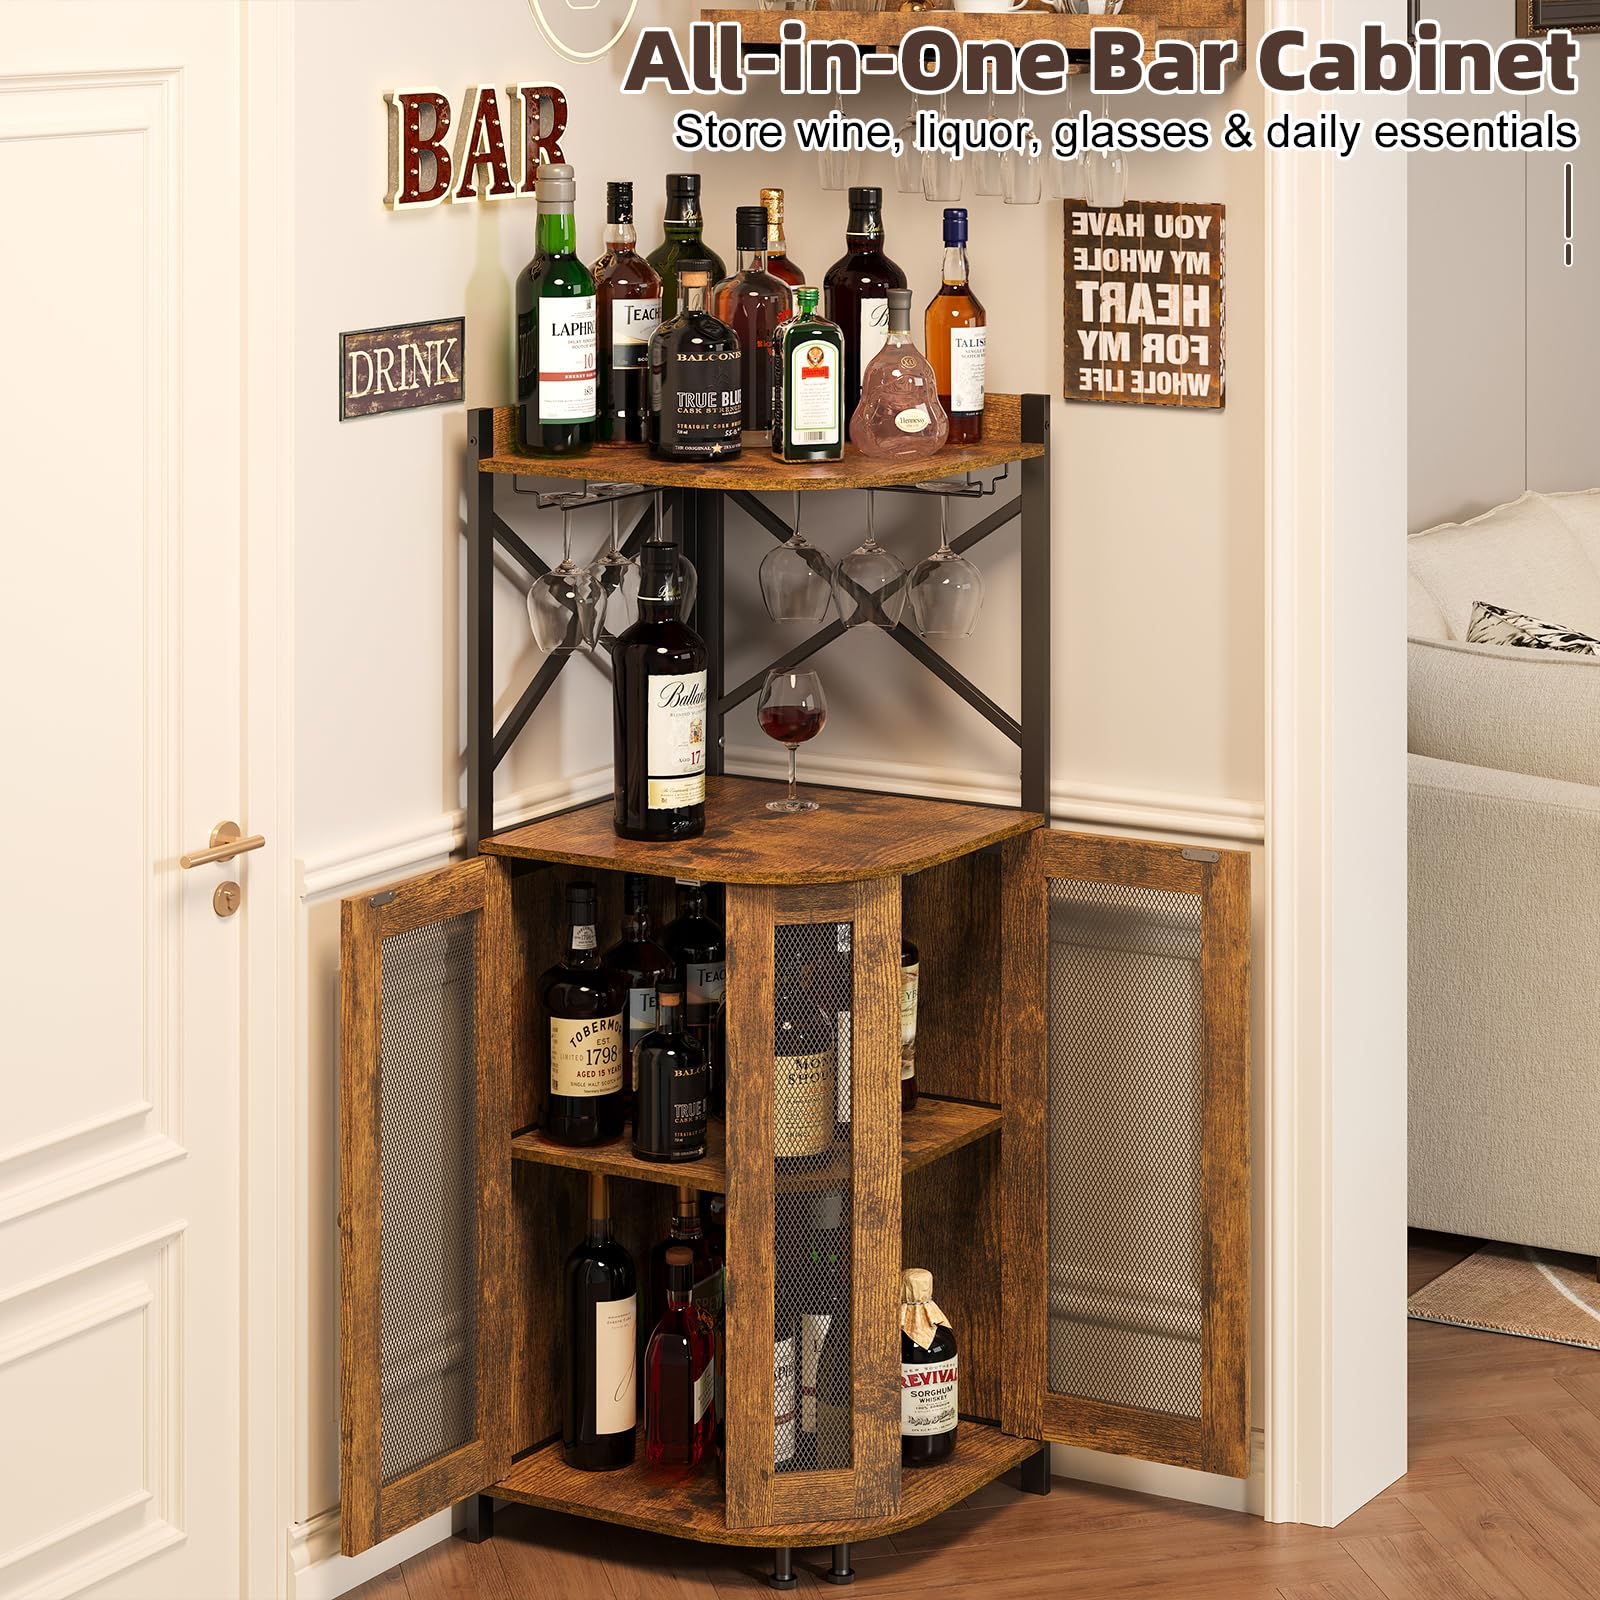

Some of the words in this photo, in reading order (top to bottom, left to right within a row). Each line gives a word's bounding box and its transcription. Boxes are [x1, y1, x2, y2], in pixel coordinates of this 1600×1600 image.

[386, 82, 568, 209] BAR
[348, 337, 460, 399] DRINK
[676, 391, 718, 408] TRUE
[691, 749, 702, 766] 17
[596, 1037, 610, 1046] EST
[586, 1044, 618, 1066] 1798
[576, 1070, 596, 1078] AGED
[598, 1069, 606, 1077] 15
[674, 1100, 702, 1118] TRUE
[910, 1384, 953, 1398] SORGHUM
[918, 1394, 948, 1404] WHISKEY
